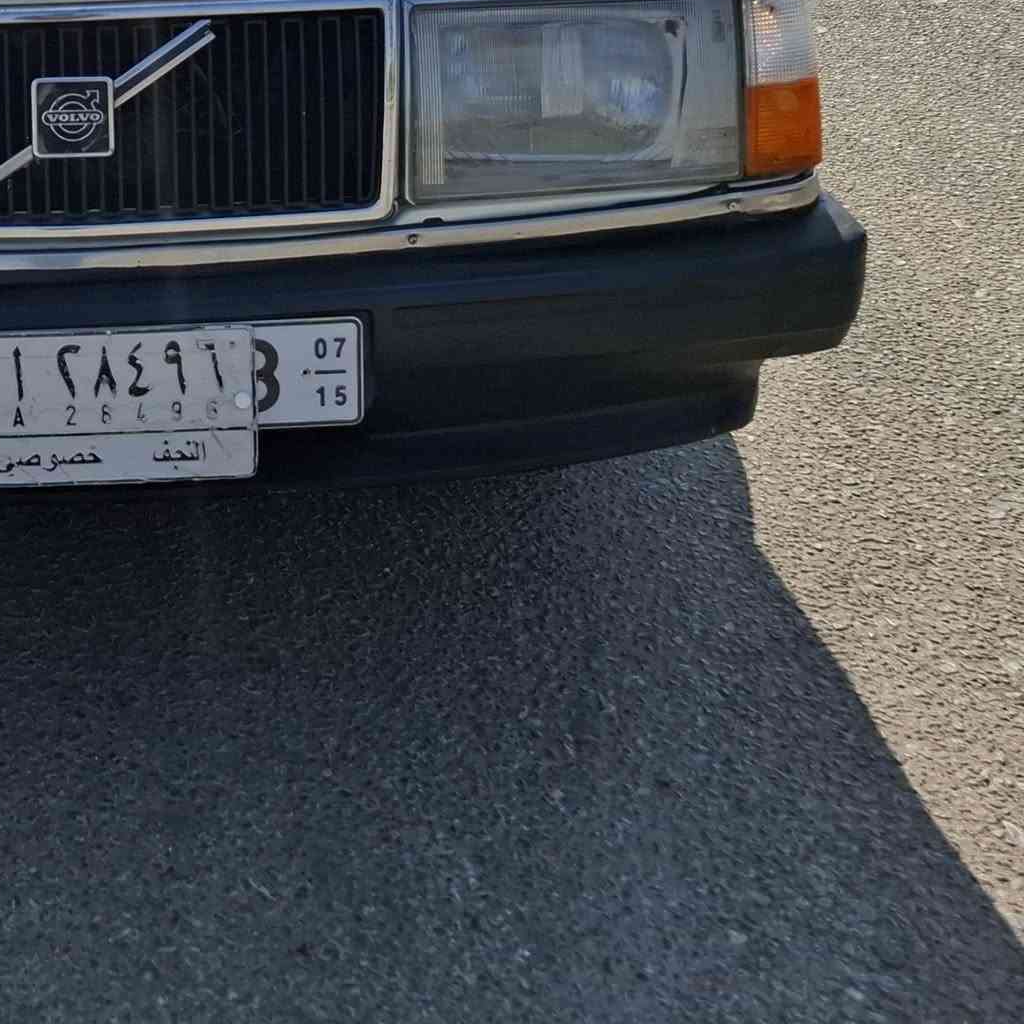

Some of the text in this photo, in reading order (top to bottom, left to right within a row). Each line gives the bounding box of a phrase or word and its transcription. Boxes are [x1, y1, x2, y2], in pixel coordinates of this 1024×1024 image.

[47, 113, 100, 122] VOLVO
[314, 337, 347, 359] 07
[315, 385, 347, 407] 15
[152, 440, 207, 470] النجف
